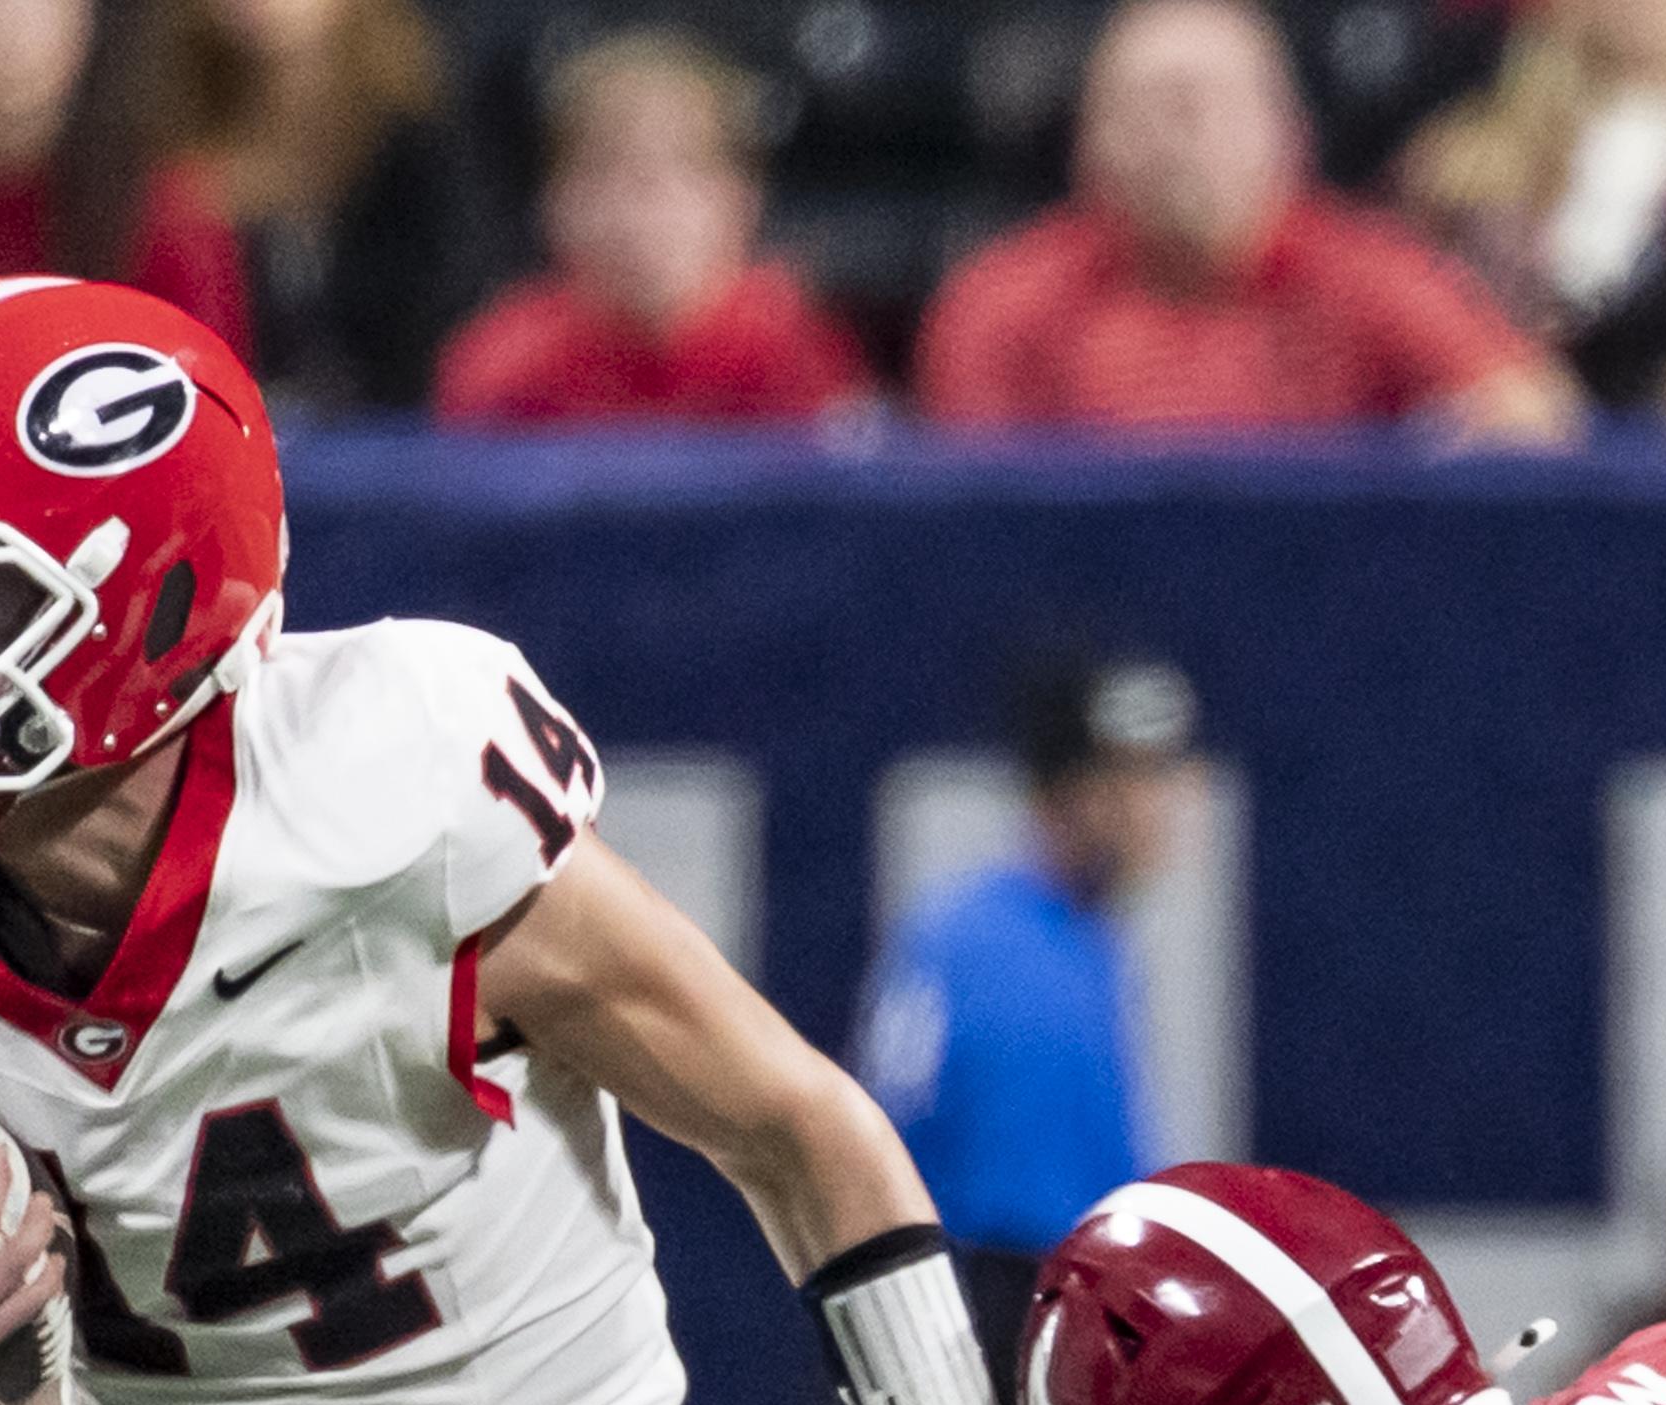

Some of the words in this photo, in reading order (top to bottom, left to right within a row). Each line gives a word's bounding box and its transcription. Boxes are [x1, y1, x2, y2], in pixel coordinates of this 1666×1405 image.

[24, 349, 189, 469] G
[479, 673, 597, 871] 14
[60, 1021, 126, 1060] G
